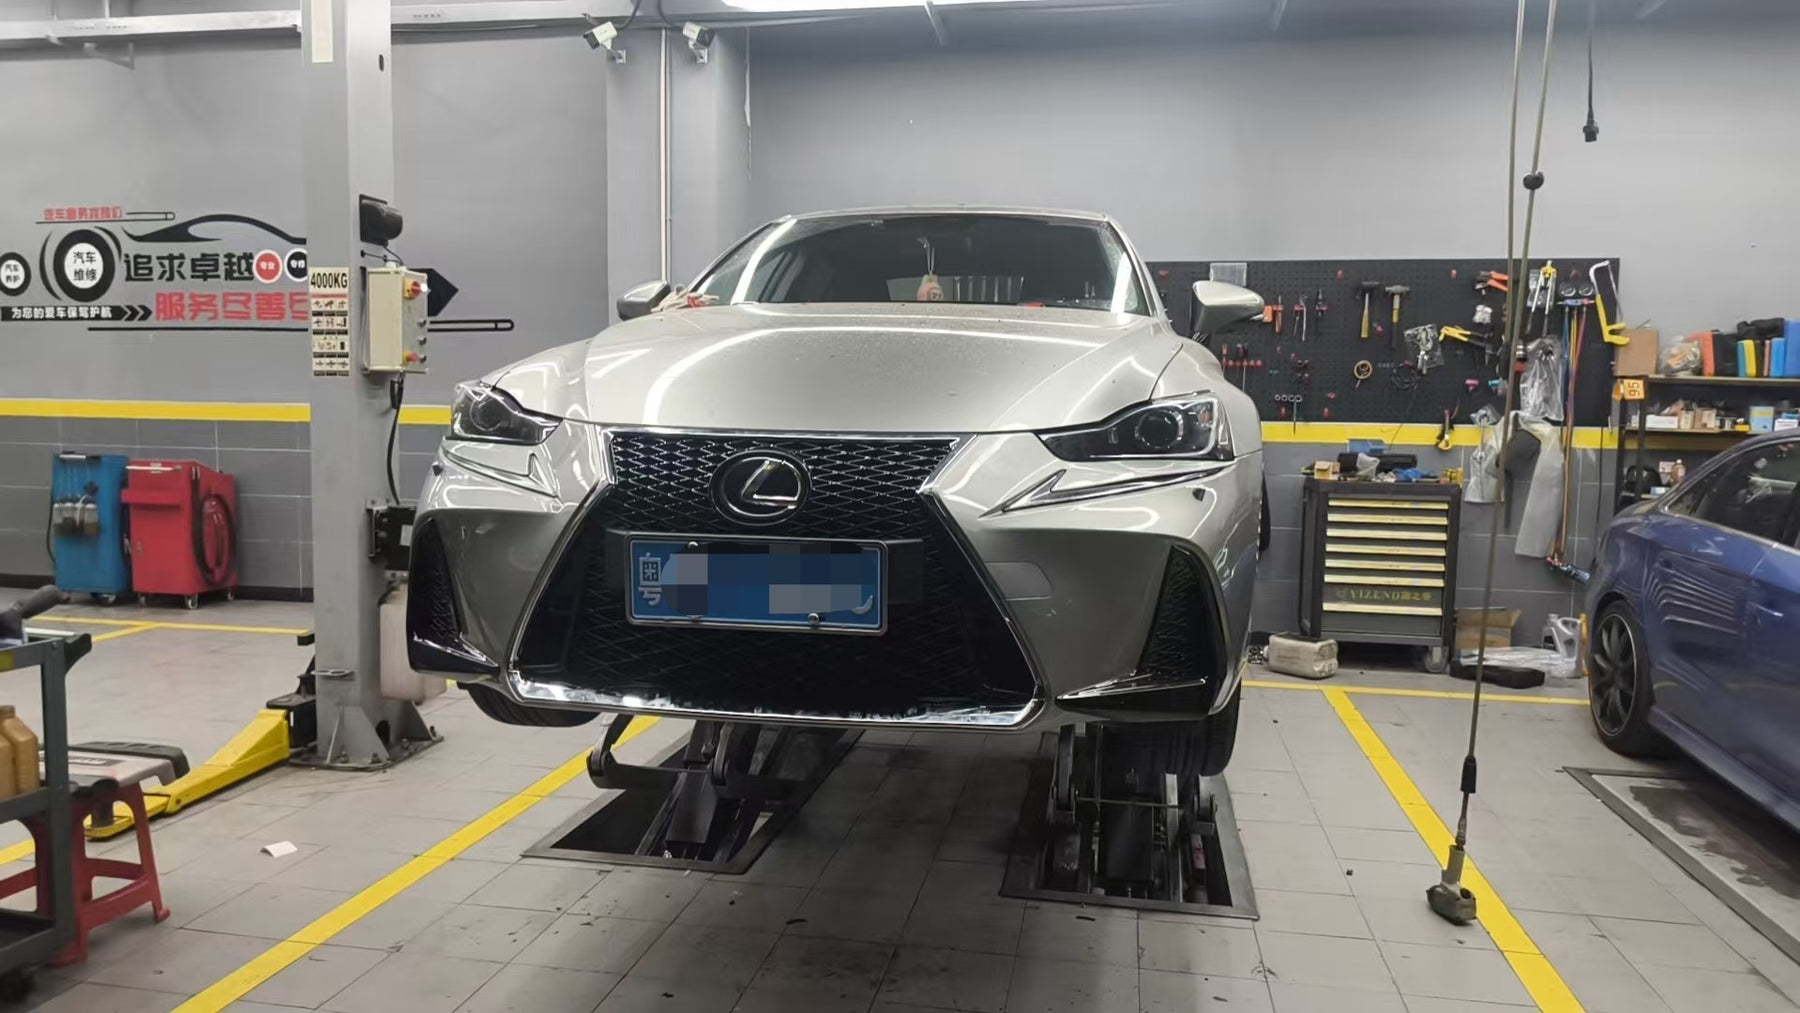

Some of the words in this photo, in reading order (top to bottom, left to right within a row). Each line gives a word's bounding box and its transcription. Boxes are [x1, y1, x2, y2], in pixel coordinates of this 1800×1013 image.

[73, 251, 97, 265] 汽车
[4, 263, 20, 273] 汽车
[123, 252, 255, 282] 追求卓越
[73, 268, 97, 282] 维修
[310, 272, 348, 289] 4000KG
[11, 306, 112, 320] 为您的爱车保驾护航
